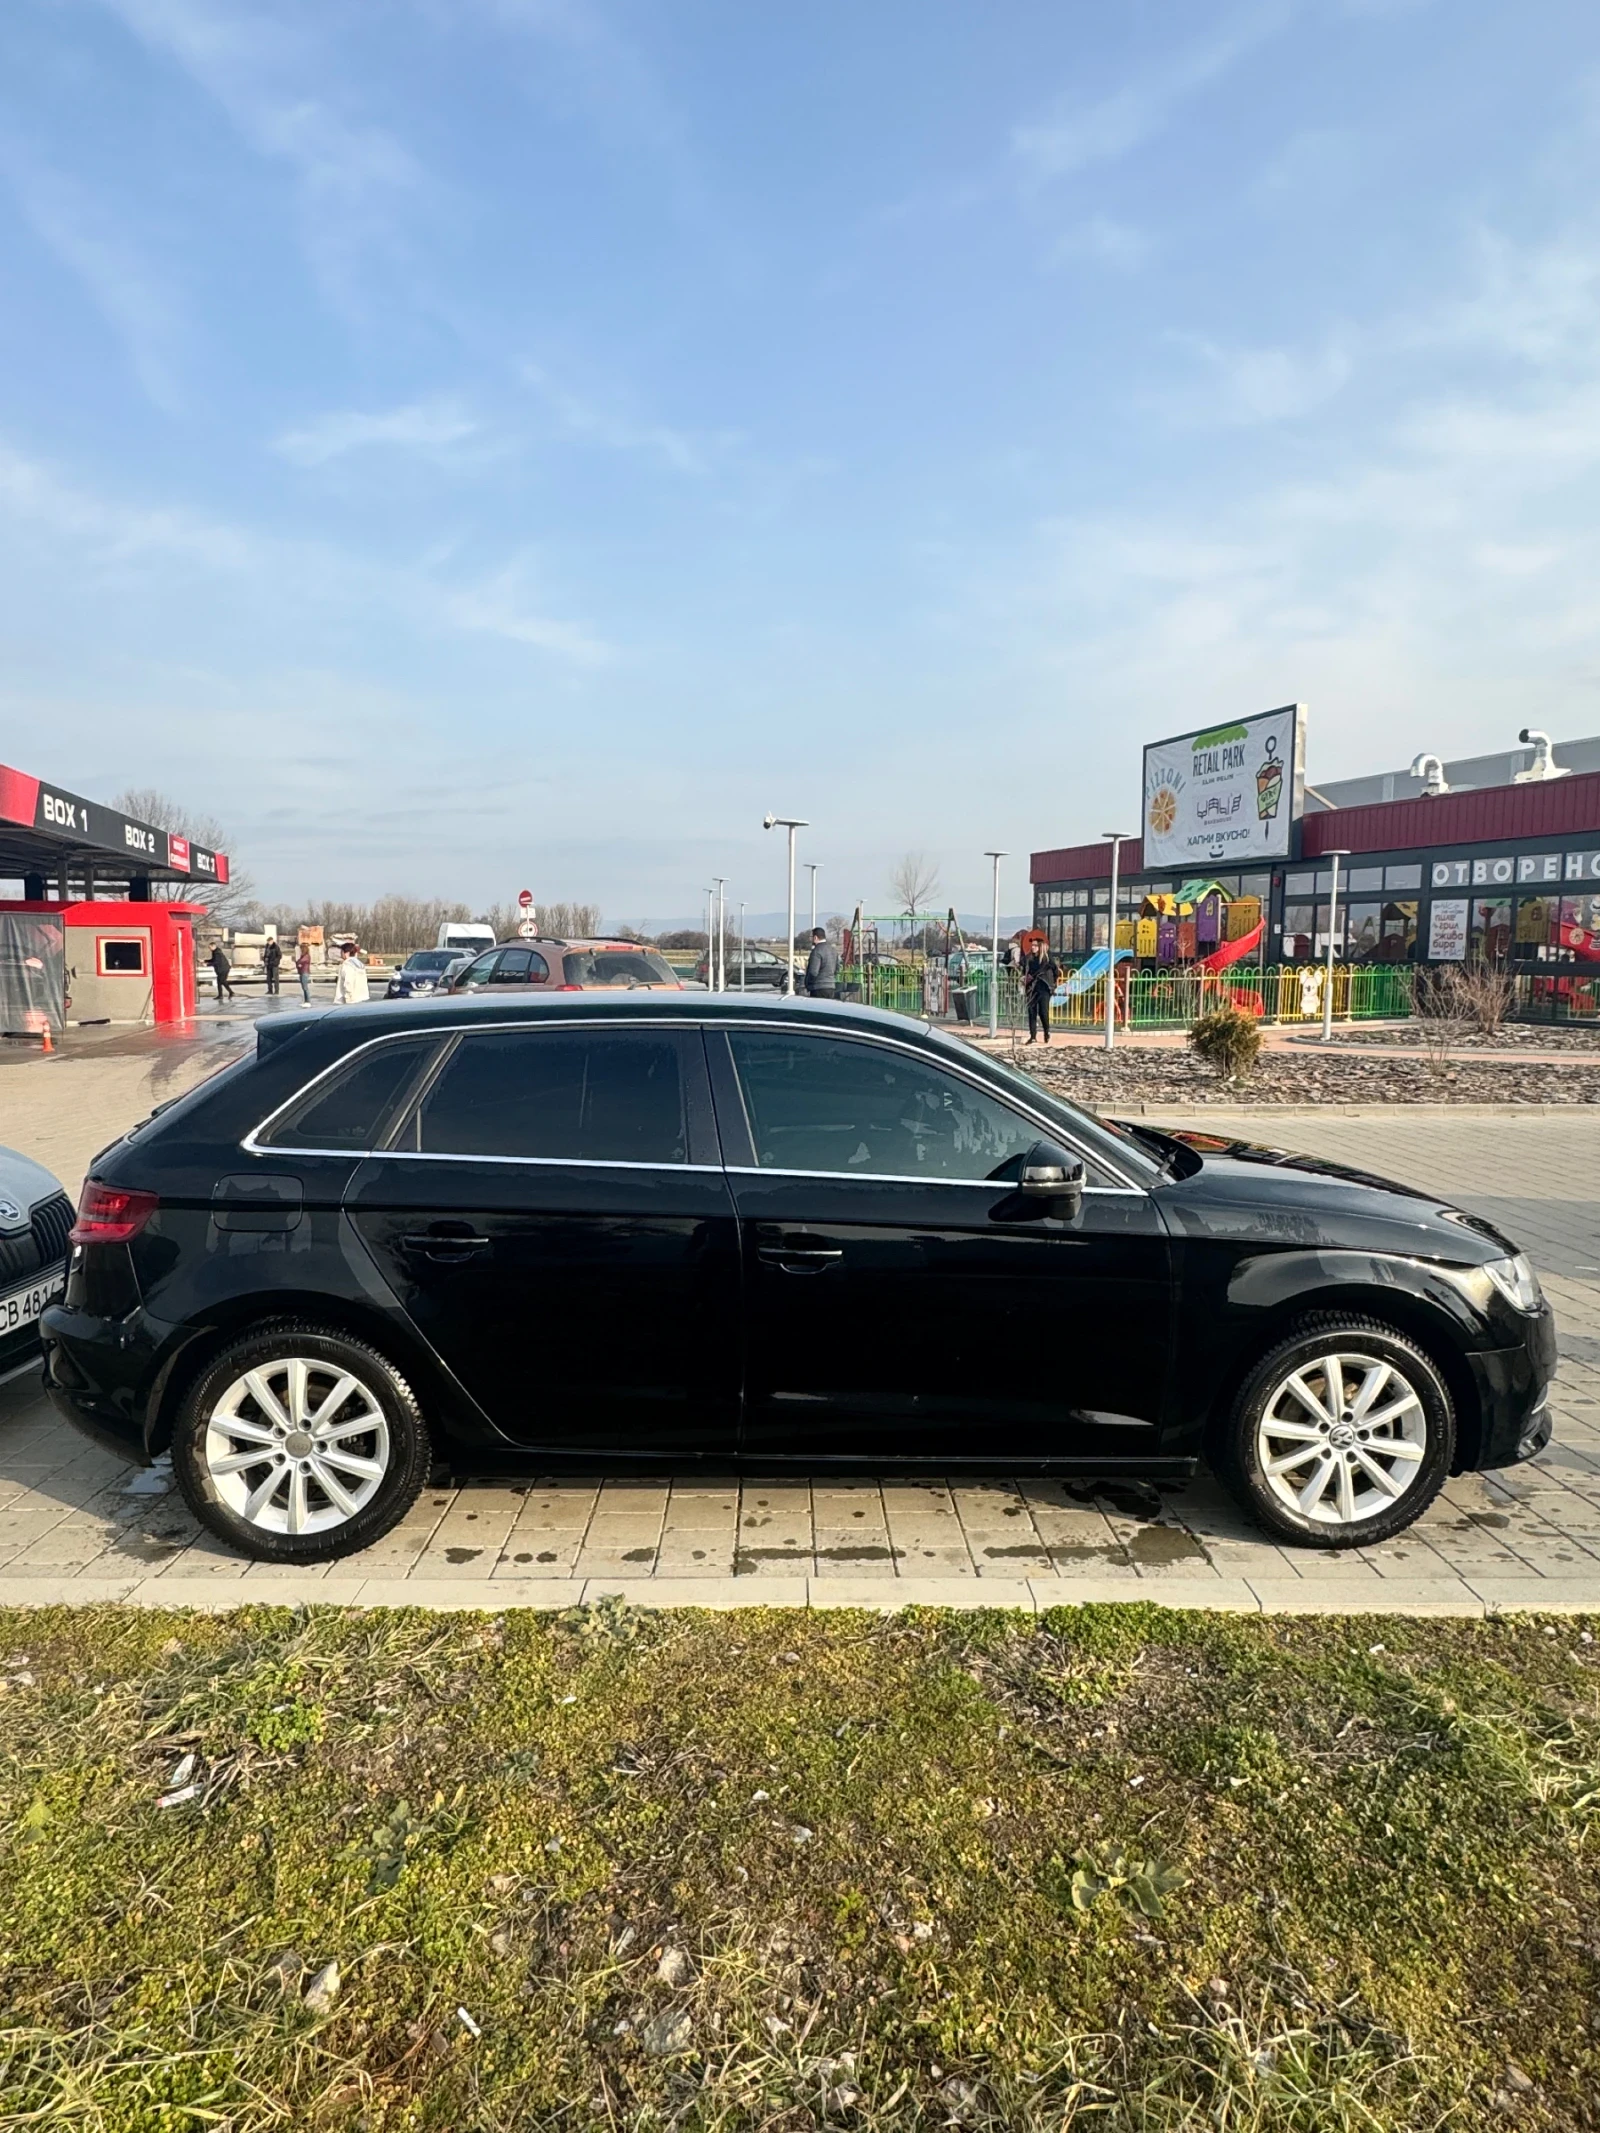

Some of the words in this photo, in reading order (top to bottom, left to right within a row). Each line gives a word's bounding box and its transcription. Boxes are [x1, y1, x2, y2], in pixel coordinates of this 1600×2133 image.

[1192, 750, 1220, 777] RETAIL
[1222, 744, 1246, 771] PARK
[43, 794, 76, 828] BOX
[80, 809, 88, 832] 1
[125, 824, 147, 850] BOX
[148, 833, 155, 853] 2
[1187, 833, 1215, 847] ХАПНИ
[1215, 828, 1251, 843] ВКУСНО!
[0, 1301, 19, 1330] CB
